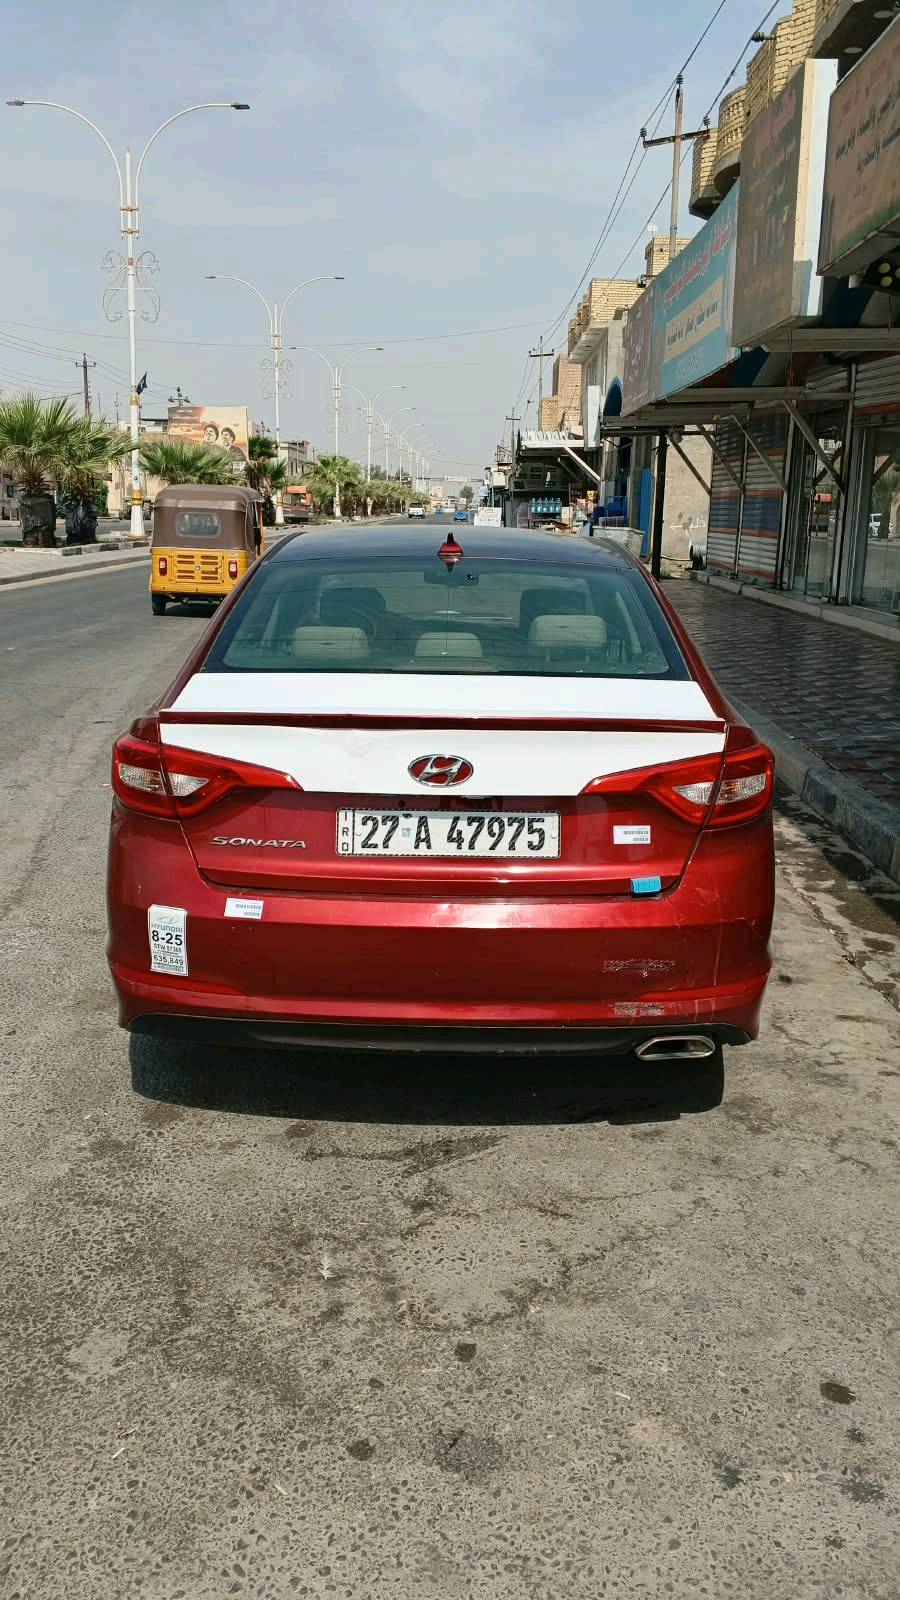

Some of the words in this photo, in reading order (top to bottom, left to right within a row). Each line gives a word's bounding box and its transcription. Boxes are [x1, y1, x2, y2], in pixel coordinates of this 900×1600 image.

[361, 815, 400, 849] 27
[413, 815, 433, 850] A
[446, 815, 546, 851] 47975
[209, 836, 307, 848] SONATA
[151, 929, 183, 946] 8-25
